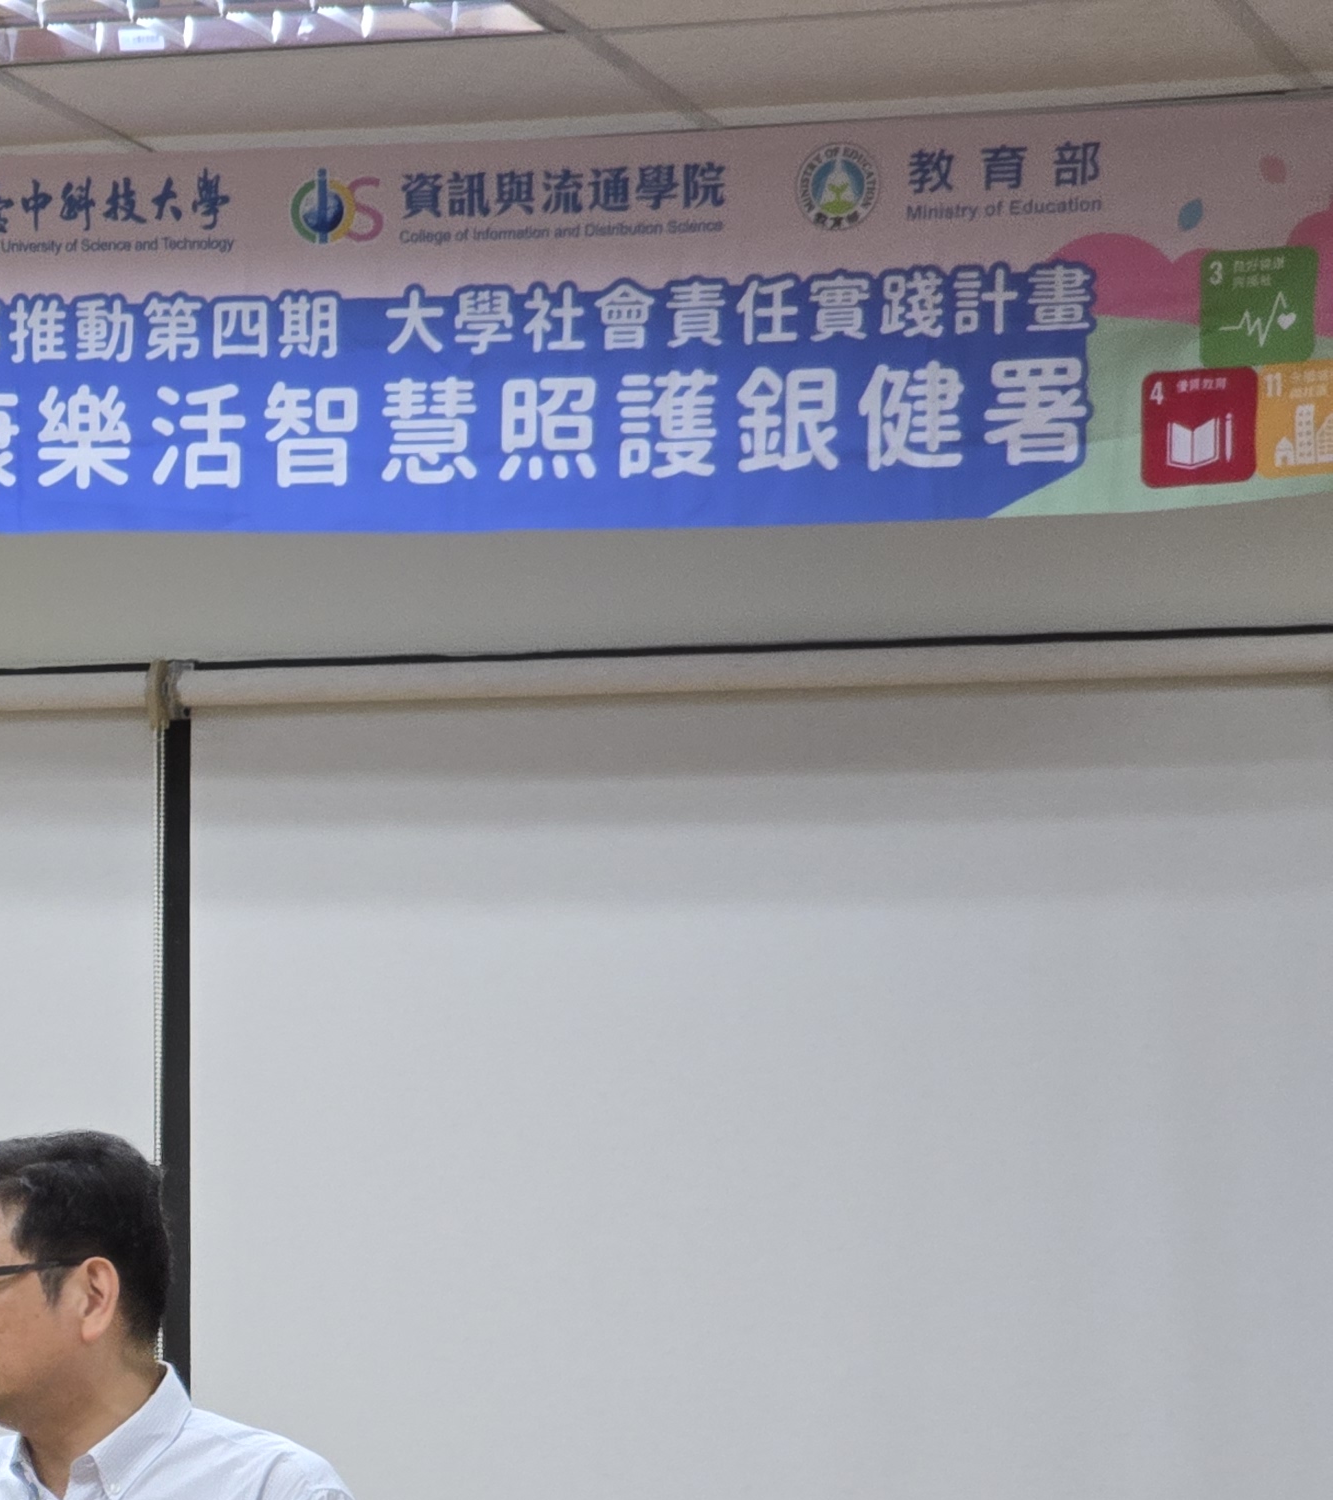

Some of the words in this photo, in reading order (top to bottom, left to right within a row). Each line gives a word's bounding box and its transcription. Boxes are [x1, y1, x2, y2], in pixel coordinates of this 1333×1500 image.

[908, 141, 1101, 194] 教育部
[401, 161, 726, 219] 資訊與流通學院
[906, 204, 978, 222] Ministry
[984, 200, 1004, 216] of
[1010, 197, 1102, 216] Education
[1, 238, 62, 255] University
[65, 238, 78, 251] of
[81, 238, 131, 252] Science
[135, 237, 158, 251] and
[162, 236, 234, 253] Technology
[399, 229, 451, 247] College
[455, 227, 469, 241] of
[473, 225, 550, 242] Information
[554, 224, 580, 239] and
[585, 221, 663, 238] Distribution
[668, 219, 723, 234] Science
[1209, 261, 1223, 285] 3
[385, 261, 1093, 354] 大學社會責任實踐計畫
[1149, 381, 1164, 405] 4
[1264, 373, 1283, 397] 11
